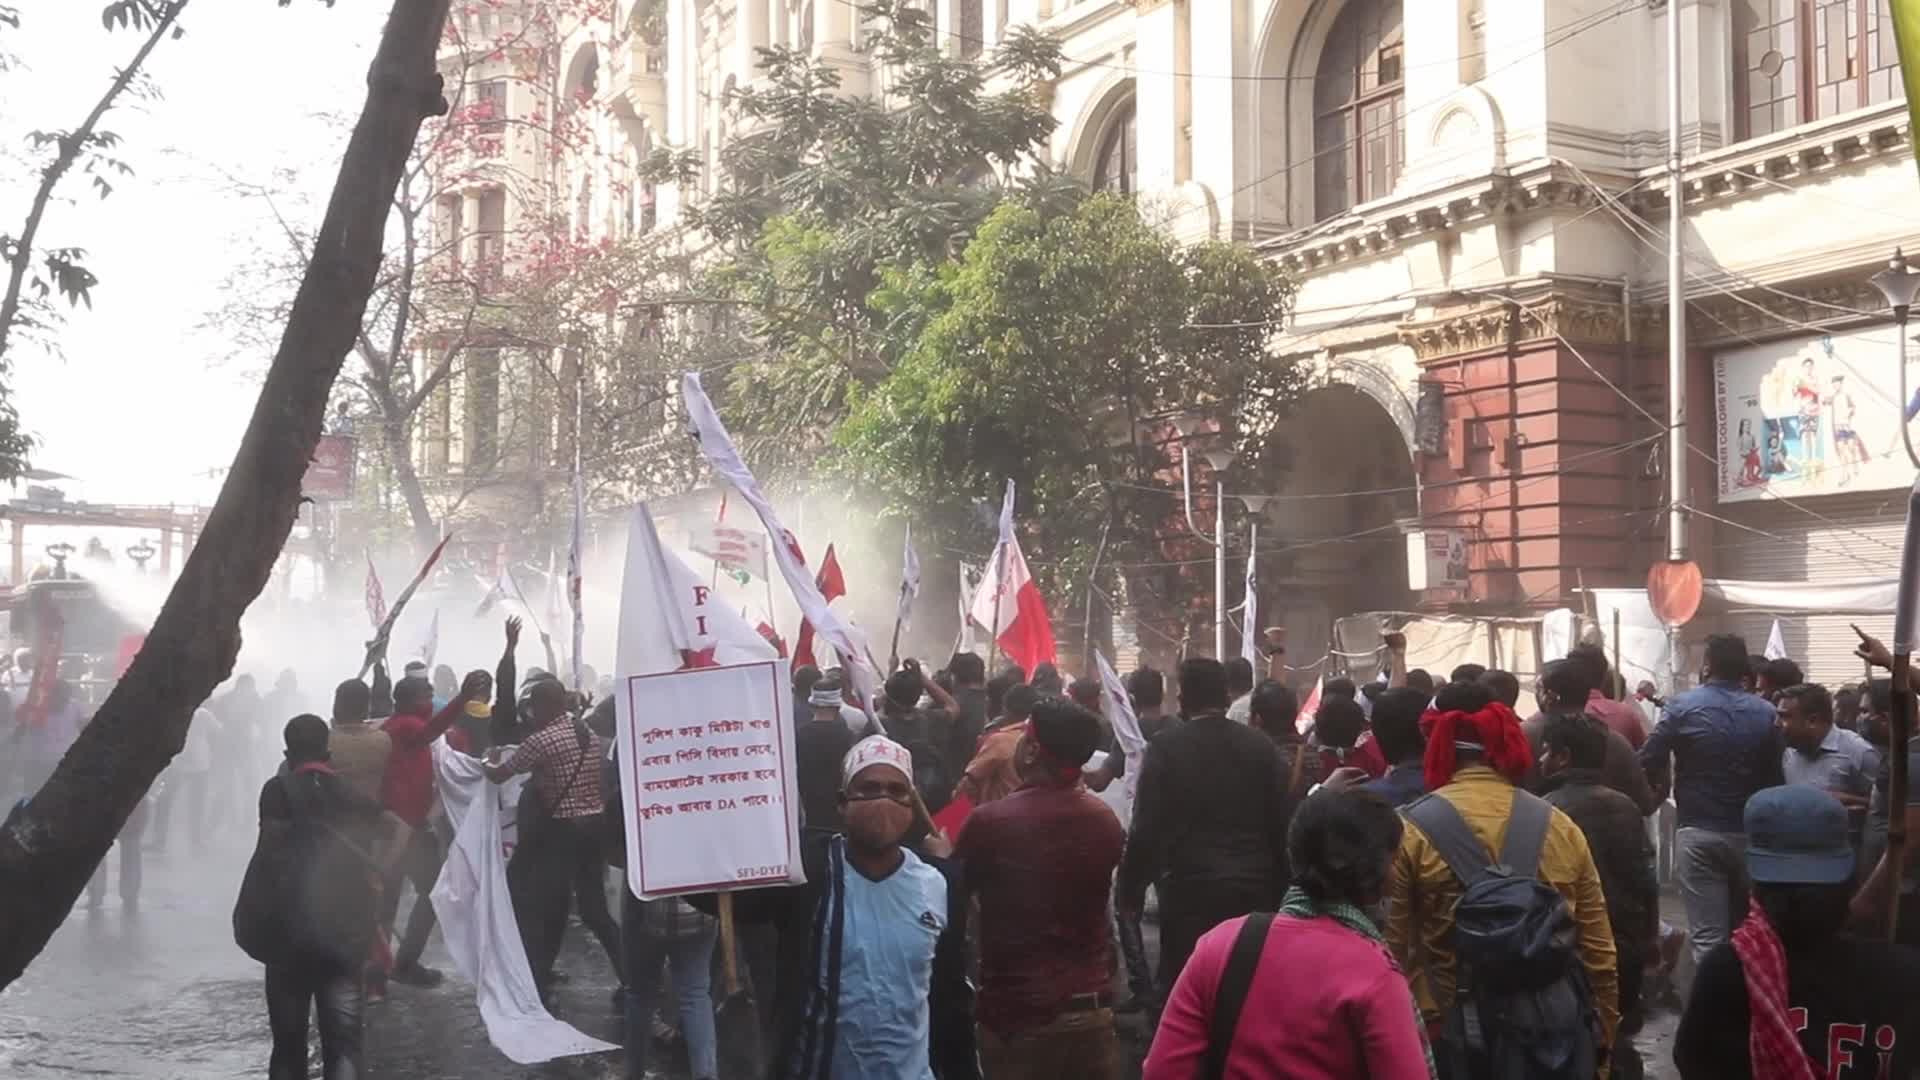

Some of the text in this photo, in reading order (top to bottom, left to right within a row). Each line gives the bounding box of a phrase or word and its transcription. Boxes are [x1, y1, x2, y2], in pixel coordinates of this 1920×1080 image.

[642, 728, 673, 744] পুলিশ
[678, 726, 704, 738] কাকু
[749, 719, 771, 729] খাও
[642, 754, 672, 767] এবার
[676, 748, 702, 763] পিসি
[643, 769, 777, 792] বামজোটের সরকার হবে
[640, 803, 673, 820] তুমিও
[677, 800, 712, 813] আবার
[718, 799, 737, 810] DA
